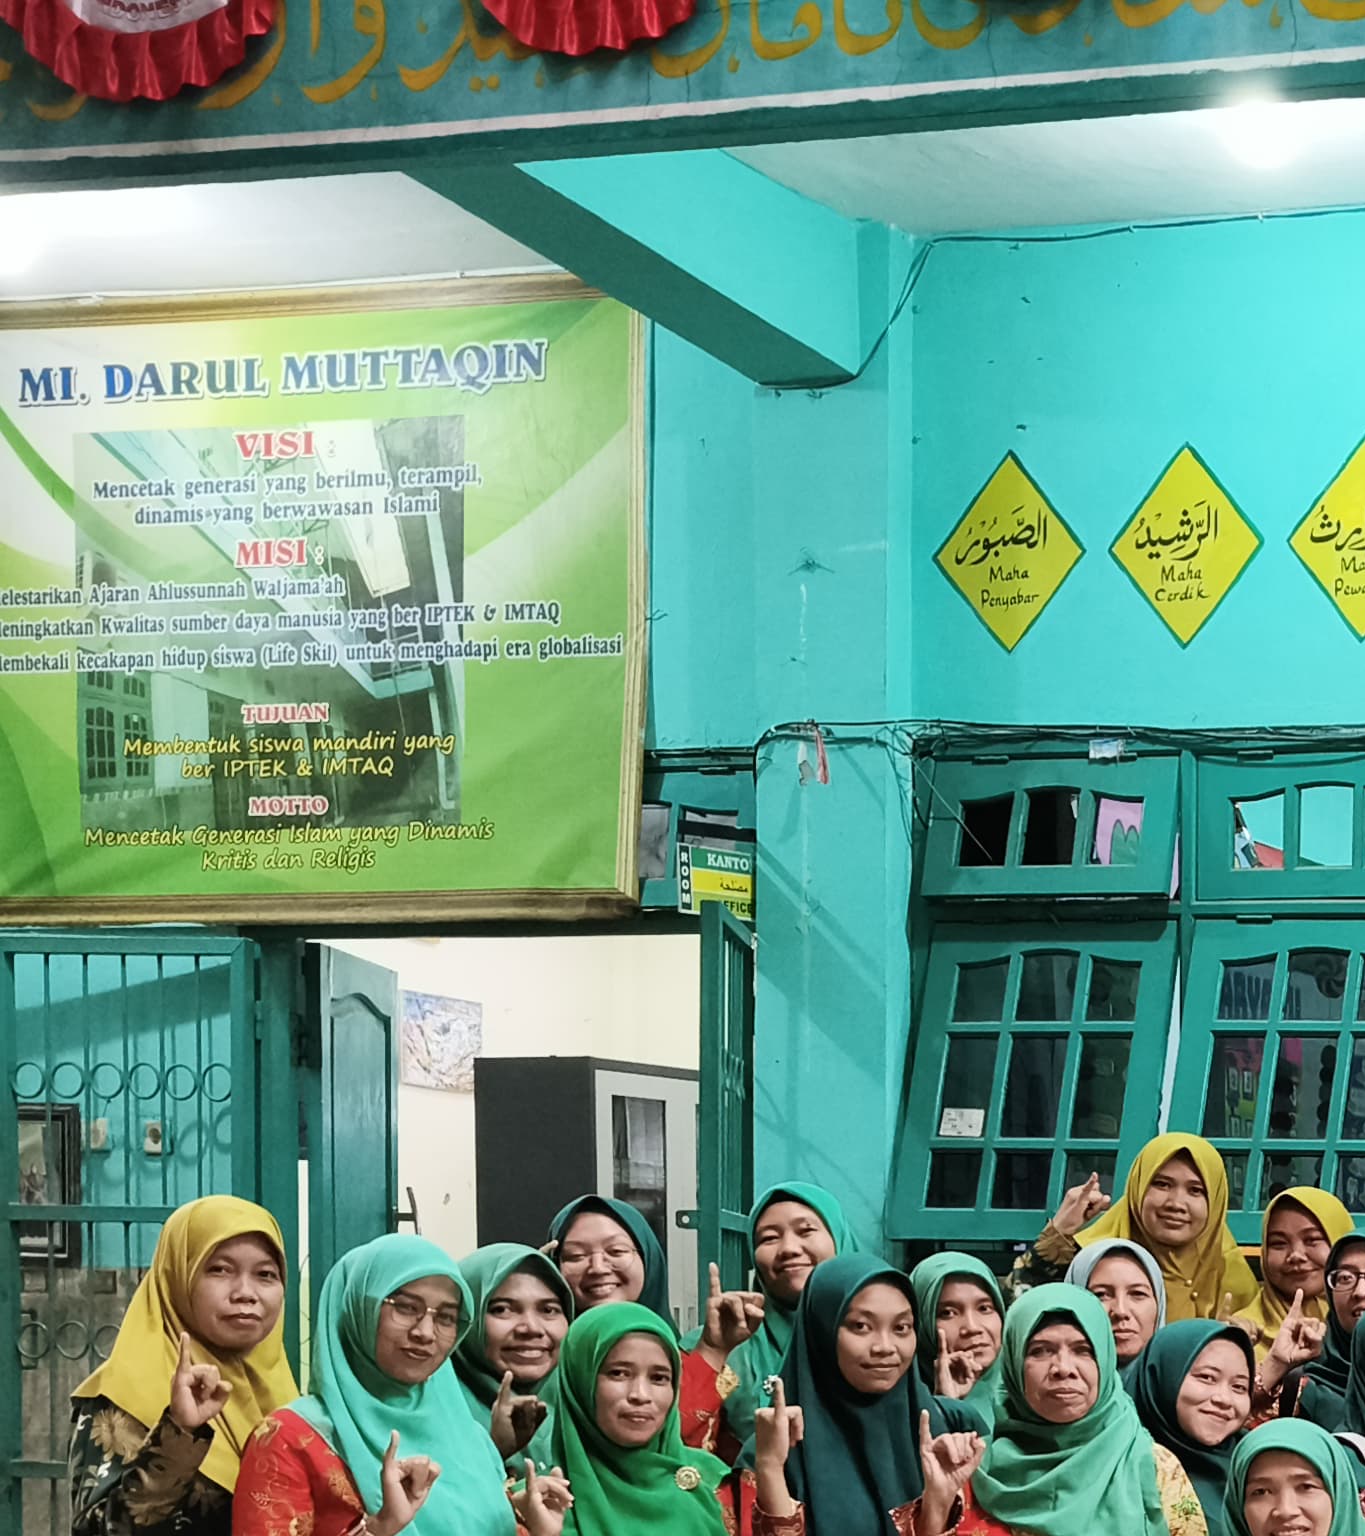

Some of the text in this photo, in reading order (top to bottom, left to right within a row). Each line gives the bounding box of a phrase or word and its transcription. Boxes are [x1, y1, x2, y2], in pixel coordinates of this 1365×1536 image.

[19, 341, 548, 402] MI. DARUL MUTTAQIN
[93, 464, 482, 499] Mencetak generasi yang berilmu, terampil,
[134, 494, 439, 525] dinamis yang berwawasan Islami
[989, 565, 1030, 583] Maha
[1161, 562, 1202, 584] Maha
[0, 577, 344, 606] elestarikan Ajaran Ahlussunnah Waljama'ah
[981, 588, 1040, 612] Penyabar
[1154, 582, 1210, 602] Cerdik
[0, 602, 560, 641] eningkatkan Kwalitas sumber daya manusia yang ber IPTEK & IMTAQ
[0, 635, 623, 674] embekali kecakapan hidup siswa (Life Skil) untuk menghadapi era globalisasi
[242, 703, 329, 724] TUJUAN
[123, 731, 455, 756] Membentuk siswa mandiri yang
[181, 756, 394, 778] ber IPTEK & IMTAQ
[248, 797, 329, 816] MOTTO
[84, 817, 495, 847] Mencetak Generasi Islam yang Dinamis
[202, 847, 376, 873] Kritis dan Religis
[707, 852, 752, 872] KANTO
[681, 853, 691, 904] ROOM
[723, 900, 752, 914] FFICE
